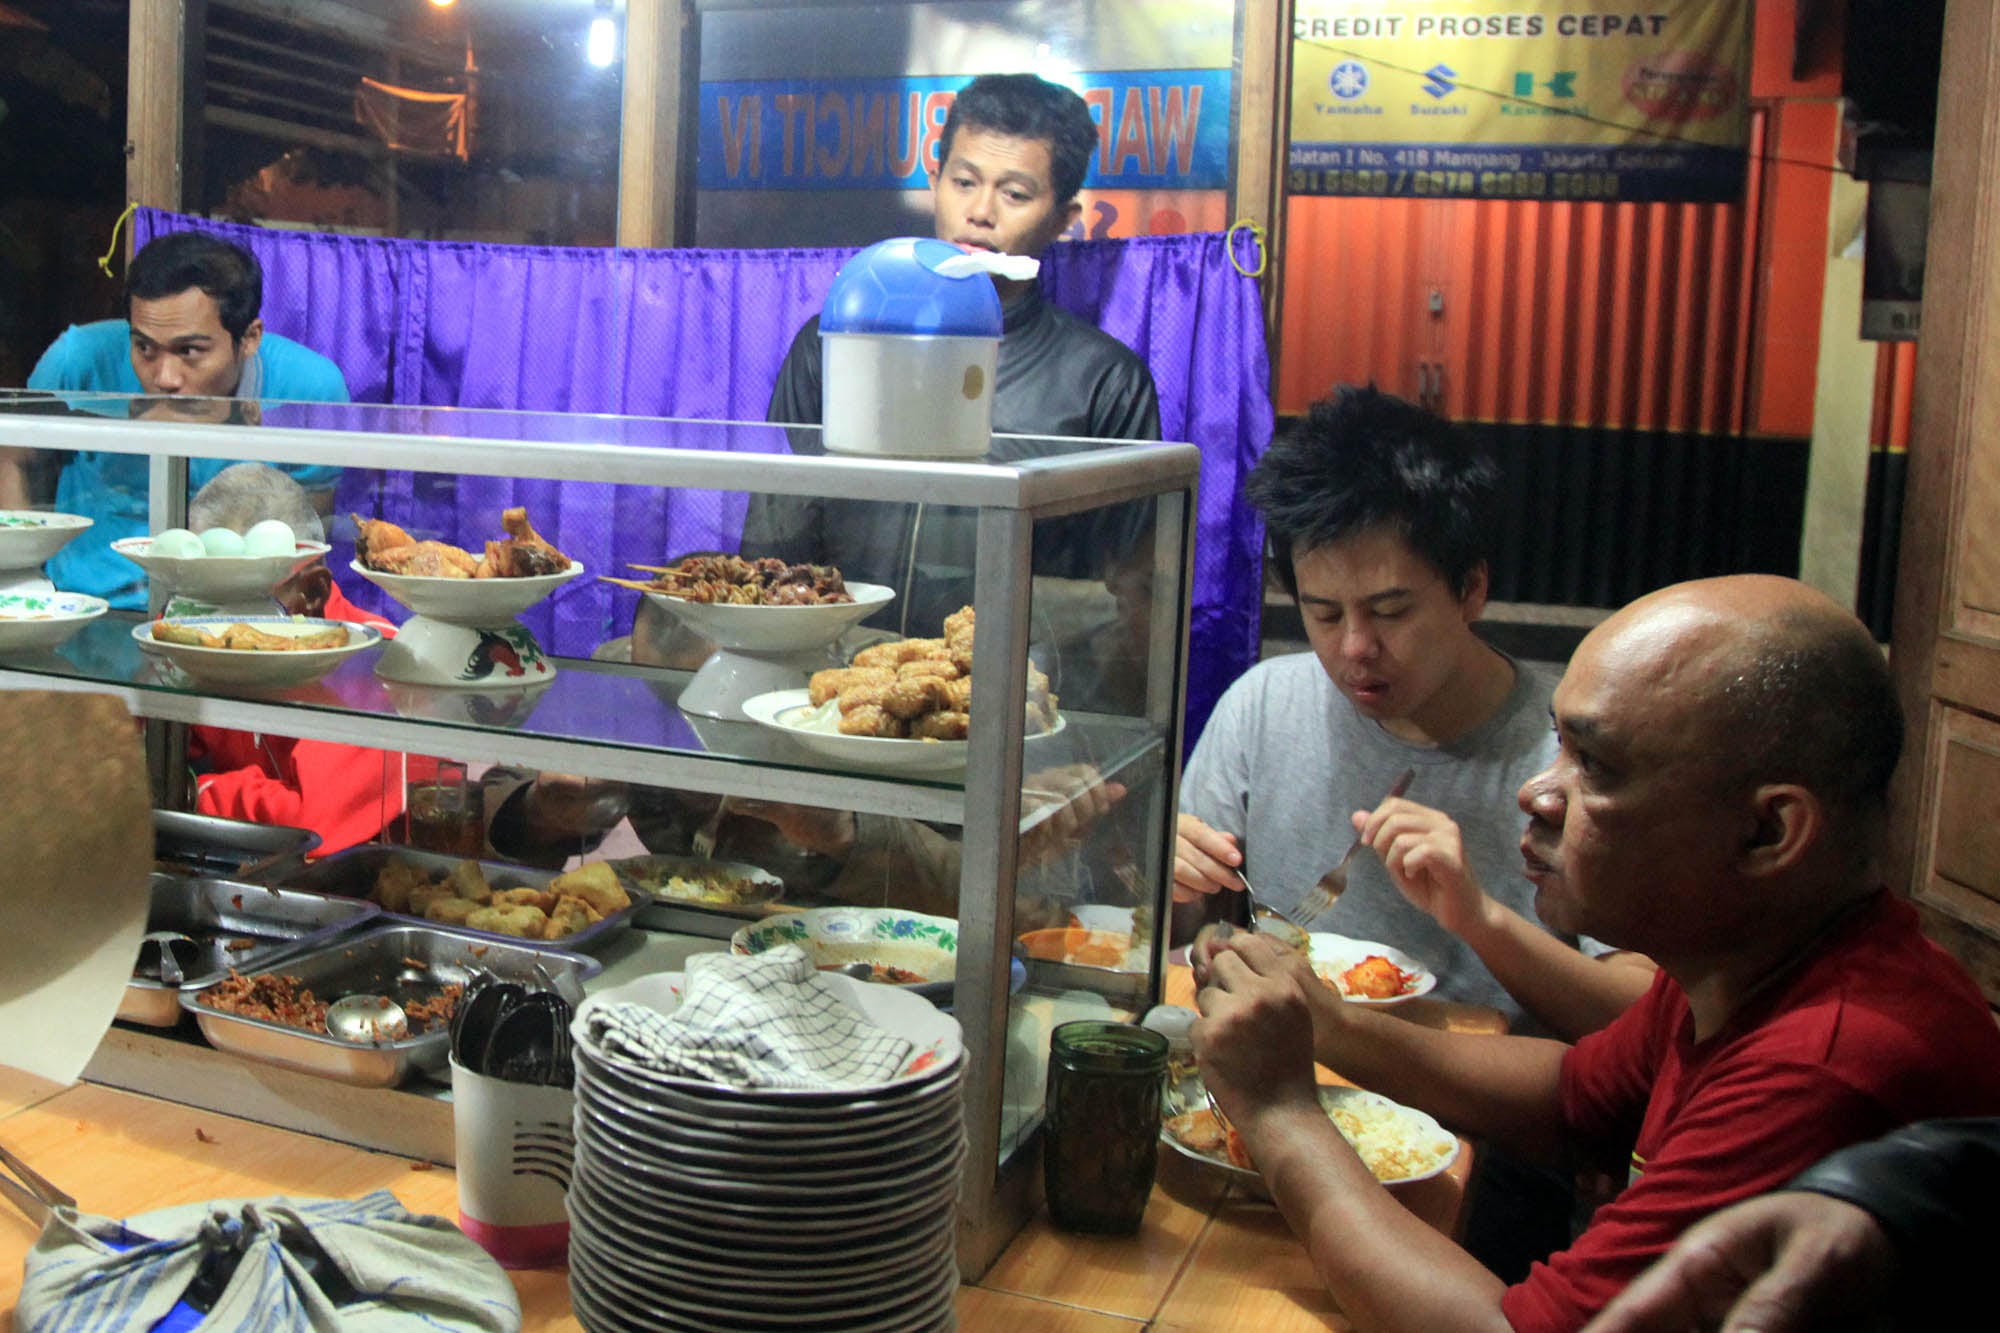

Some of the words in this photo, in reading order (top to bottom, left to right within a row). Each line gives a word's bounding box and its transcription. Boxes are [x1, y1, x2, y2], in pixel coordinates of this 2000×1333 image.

[1294, 17, 1403, 38] CREDIT
[1417, 15, 1544, 36] PROSES
[1557, 14, 1668, 37] CEPAT
[1314, 103, 1383, 116] Yamaha
[1410, 103, 1468, 116] Suzuki
[1359, 149, 1388, 168] No.
[1434, 149, 1521, 172] Mampang
